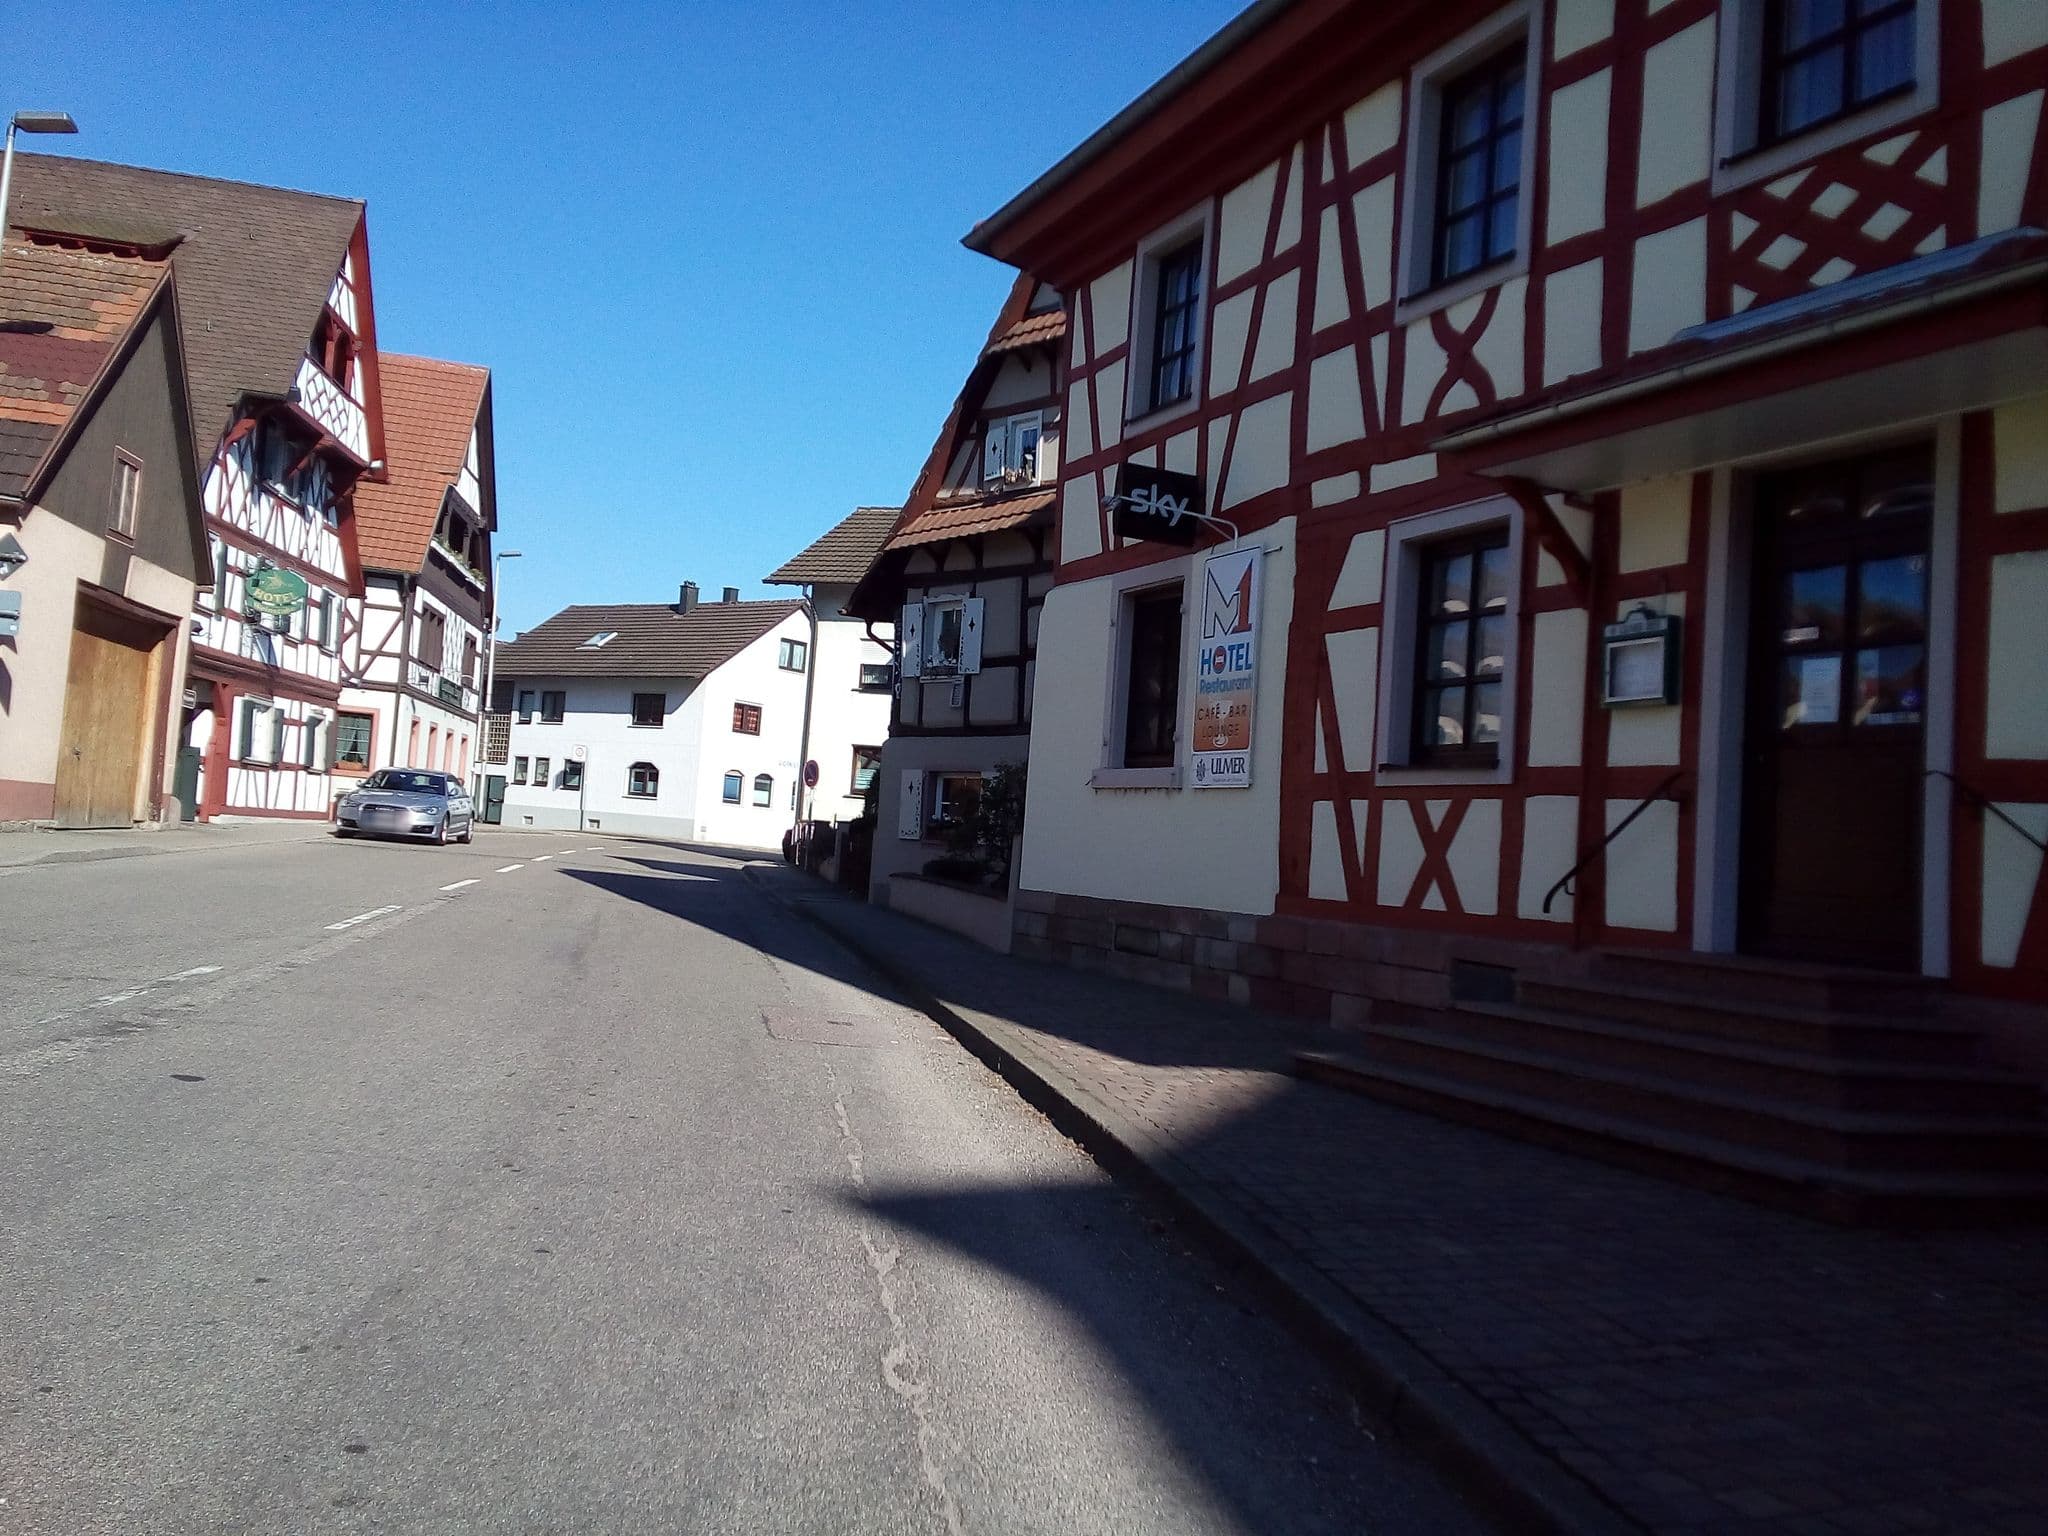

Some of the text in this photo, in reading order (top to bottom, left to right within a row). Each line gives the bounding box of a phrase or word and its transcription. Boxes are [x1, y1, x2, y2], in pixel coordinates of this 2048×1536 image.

[1130, 482, 1190, 527] sky
[255, 588, 294, 602] HOTEL
[1200, 643, 1252, 675] HOTEL
[1200, 673, 1252, 694] Restaurant
[1229, 704, 1248, 718] BAR
[1202, 721, 1240, 738] LOUNGE
[1211, 757, 1246, 774] ULMER
